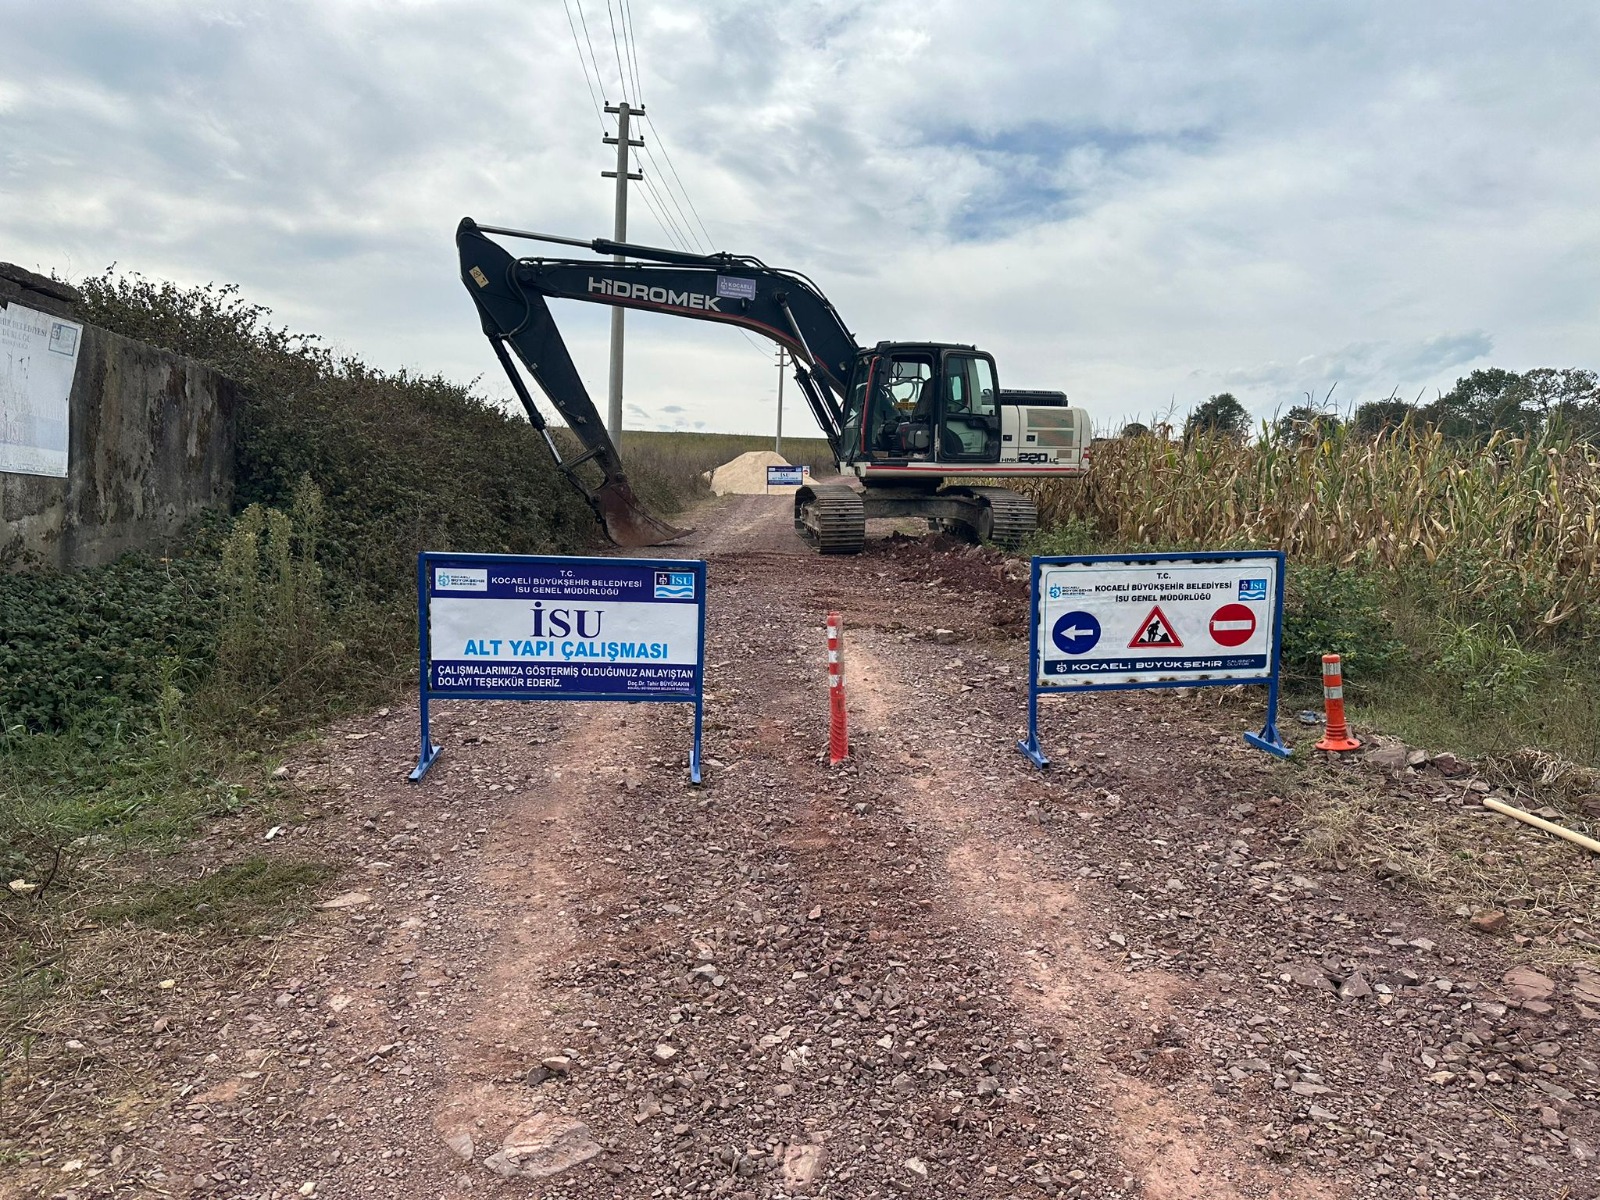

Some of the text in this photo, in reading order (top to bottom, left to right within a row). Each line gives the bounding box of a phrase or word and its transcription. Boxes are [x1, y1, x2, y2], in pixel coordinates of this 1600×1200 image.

[1018, 453, 1048, 463] 220
[491, 577, 643, 588] KOCAELİ BÜYÜKŞEHİR BELEDİYESİ
[669, 574, 692, 586] İSU
[1094, 580, 1232, 592] KOCAELİ BÜYÜKŞEHİR BELEDİYESİ
[1249, 581, 1265, 590] İSU
[532, 586, 562, 594] GENEL
[563, 587, 619, 595] MÜDÜRLÜĞÜ
[1115, 593, 1212, 603] İSU GENEL MÜDÜRLÜĞÜ
[529, 601, 605, 639] İSU
[464, 640, 668, 662] ALT YAPI ÇALIŞMASI
[438, 665, 694, 680] ÇALIŞMALARIMIZA GÖSTERMİŞ OLDUĞUNUZ ANLAYIŞTAN
[438, 676, 562, 688] DOLAYI TEŞEKKÜR EDERİZ.
